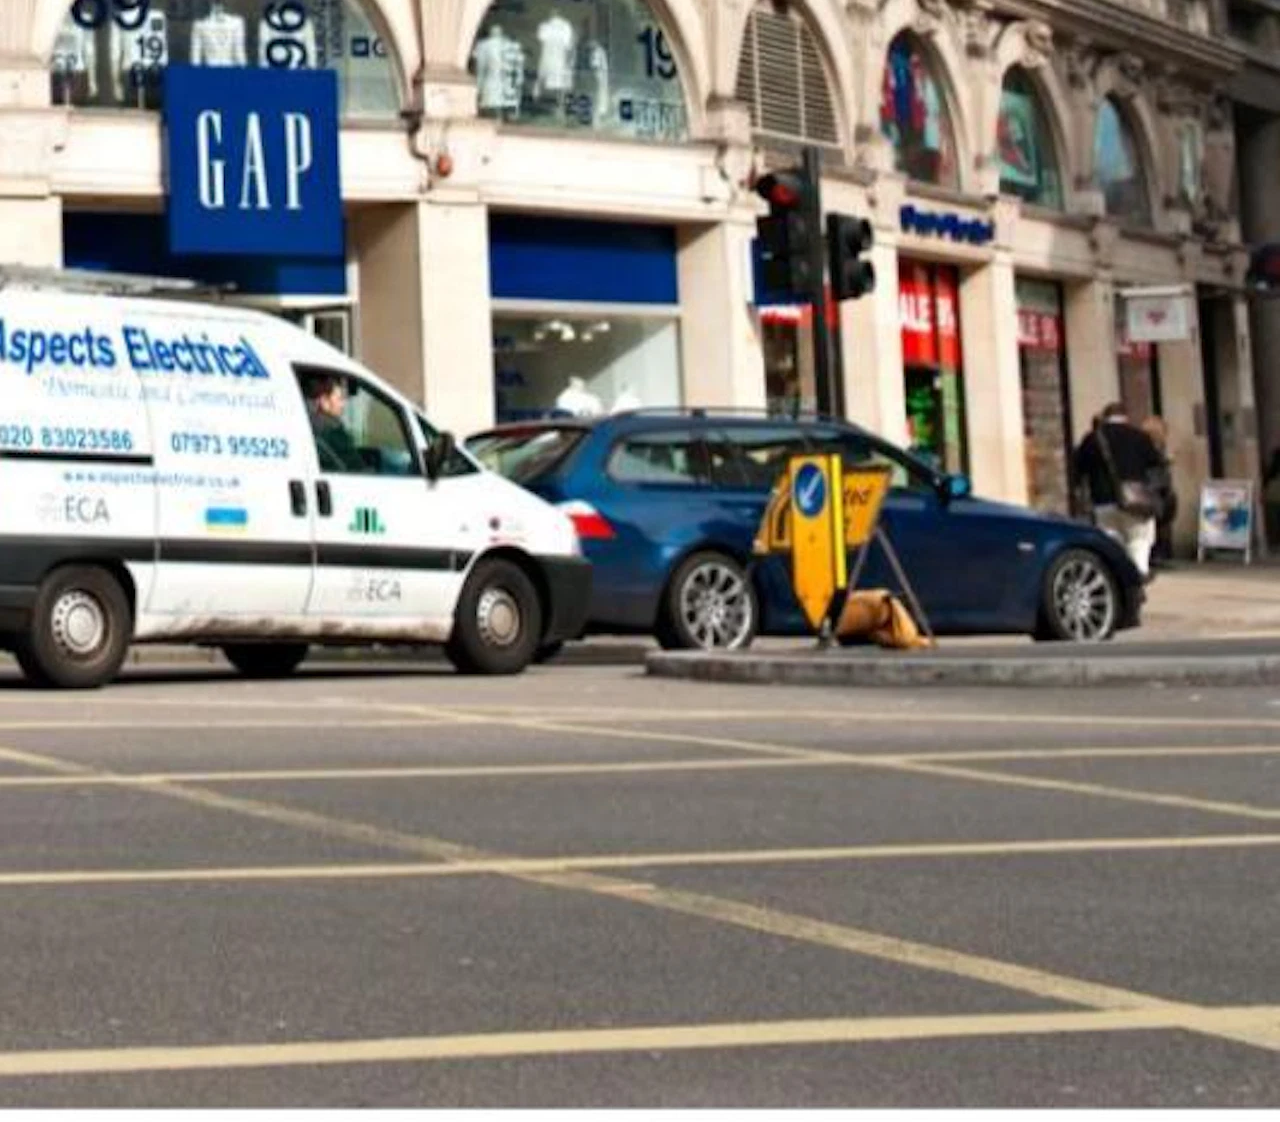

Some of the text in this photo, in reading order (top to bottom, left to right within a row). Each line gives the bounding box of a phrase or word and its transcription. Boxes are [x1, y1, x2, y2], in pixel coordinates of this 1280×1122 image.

[197, 109, 313, 210] GAP
[122, 324, 270, 379] Electrical
[42, 427, 133, 451] 83023586
[64, 495, 110, 523] ECA
[365, 579, 402, 603] ECA
